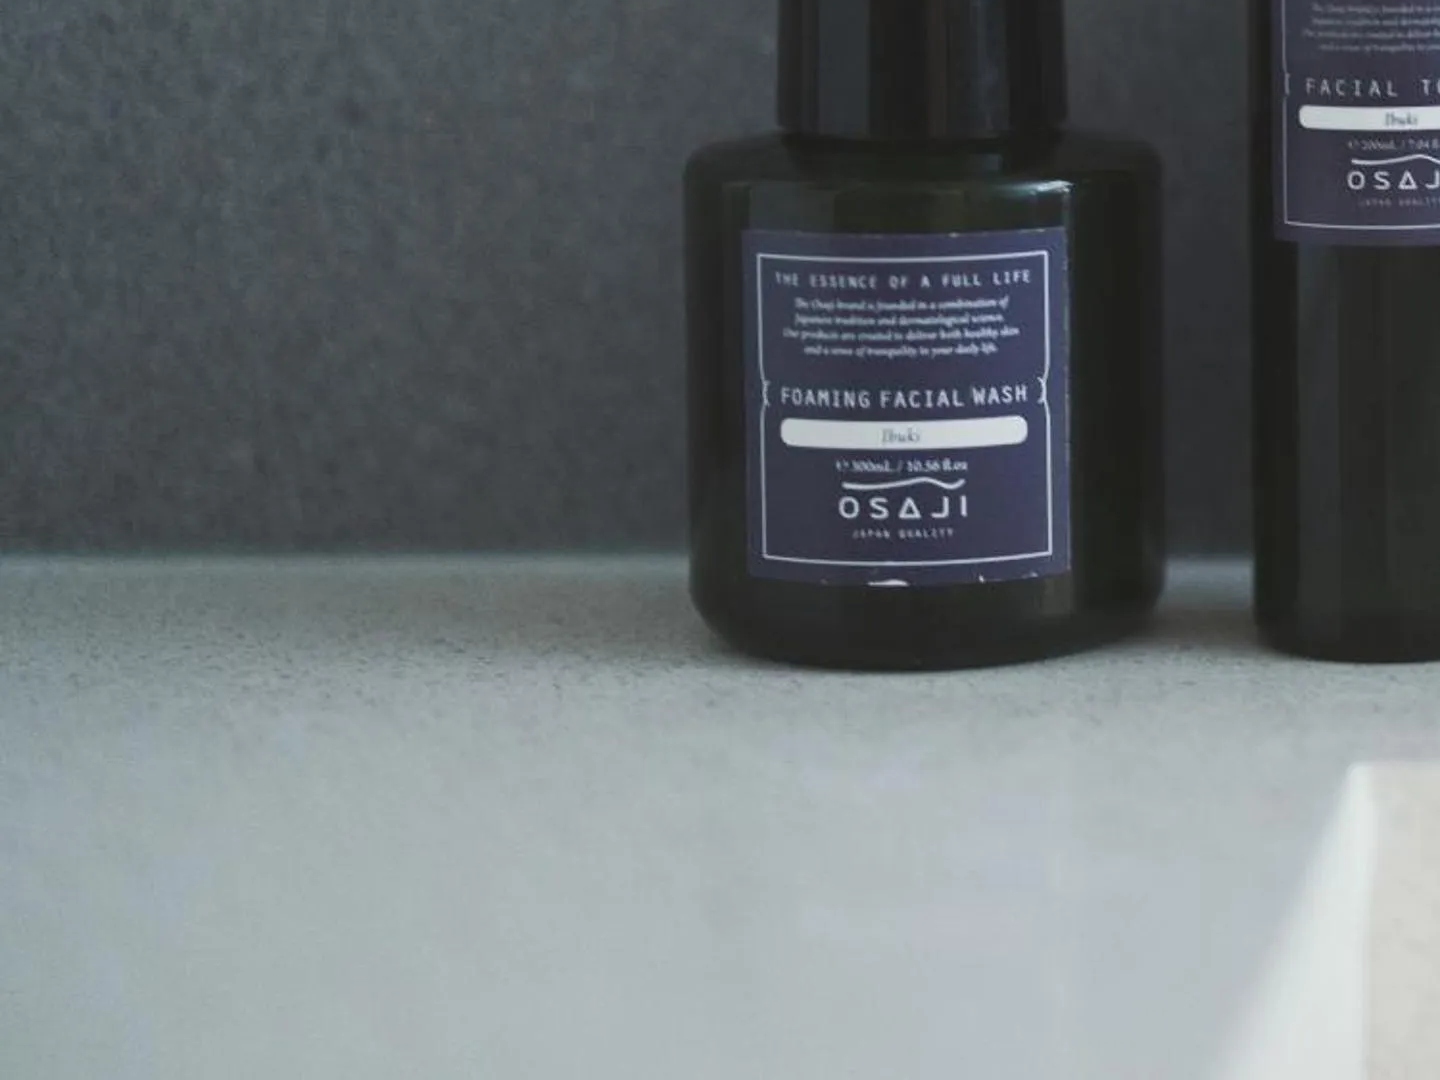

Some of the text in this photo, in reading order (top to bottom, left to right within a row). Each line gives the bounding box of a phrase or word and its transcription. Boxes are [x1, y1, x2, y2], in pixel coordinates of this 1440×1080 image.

[1306, 78, 1398, 97] FACIAL
[776, 269, 1030, 289] THE ESSENCE OF A FULL LIFE
[780, 385, 1028, 408] FOAMING FACIAL WASH
[838, 495, 968, 519] OSAJI
